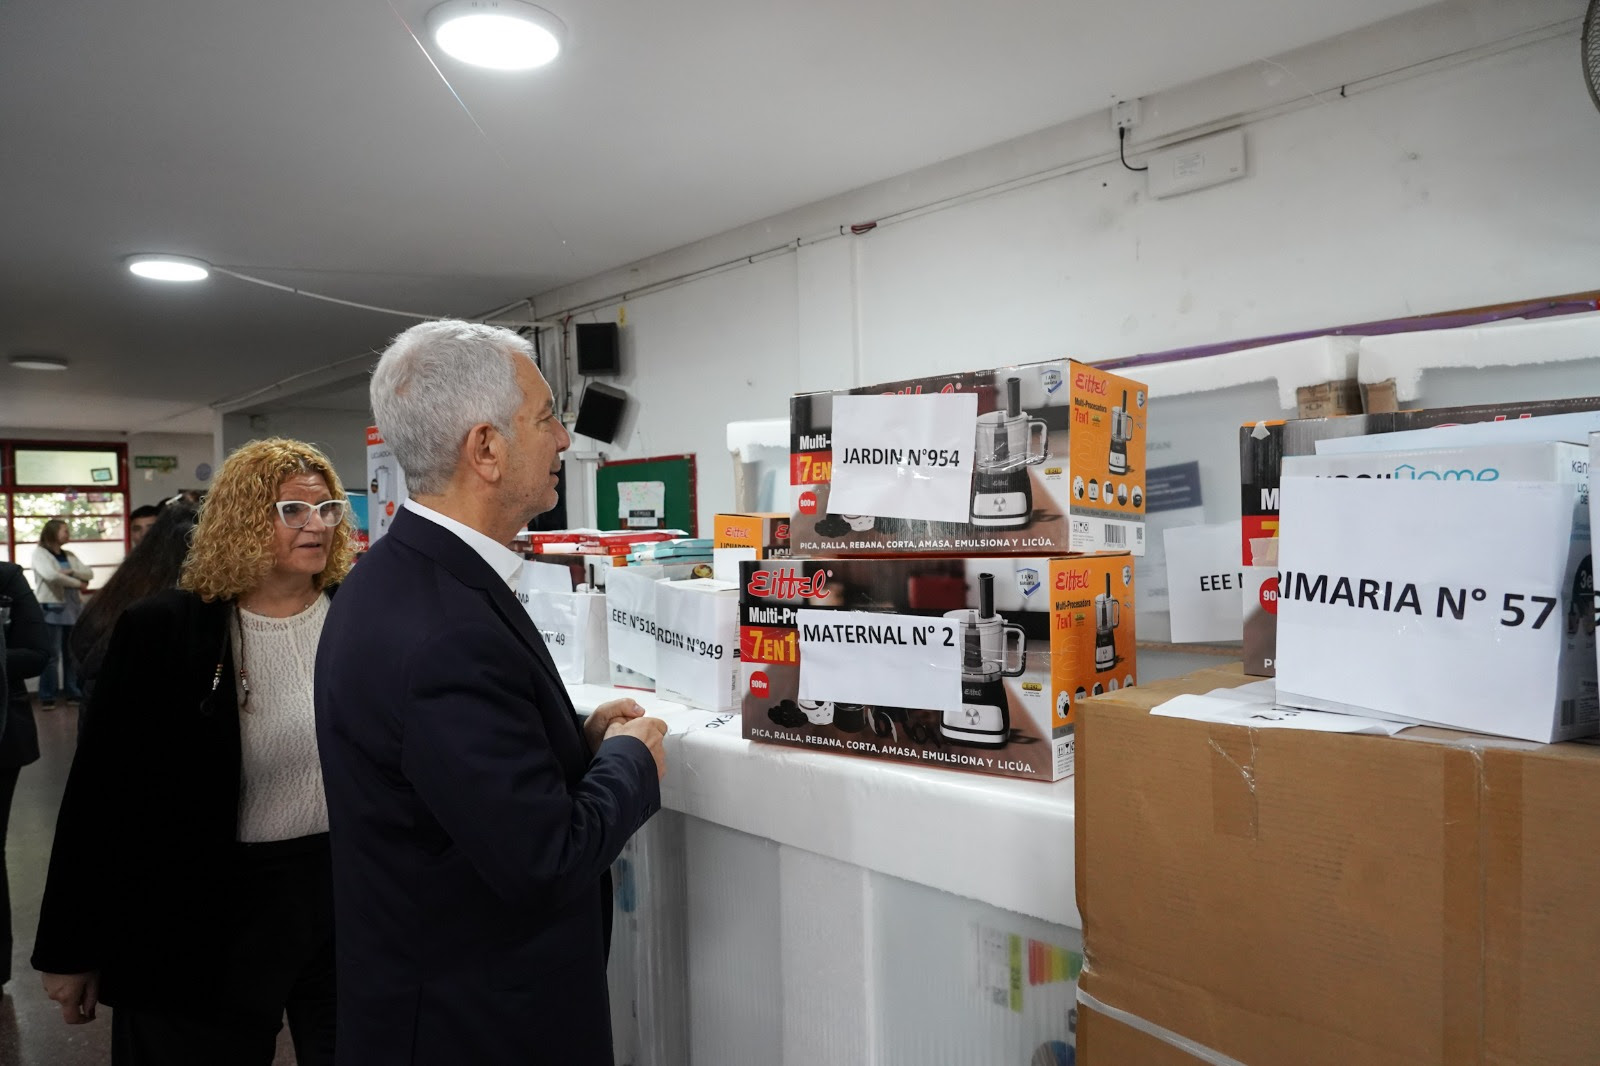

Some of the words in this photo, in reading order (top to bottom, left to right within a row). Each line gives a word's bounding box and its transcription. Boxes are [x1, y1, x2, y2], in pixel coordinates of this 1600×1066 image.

[800, 433, 832, 450] Multi-
[800, 456, 832, 482] 7EN
[843, 448, 902, 465] JARDIN
[908, 449, 960, 467] N°954
[800, 542, 820, 550] PICA,
[821, 541, 848, 550] RALLA,
[850, 541, 885, 549] REBANA,
[887, 540, 917, 549] CORTA,
[919, 540, 953, 549] AMASA,
[955, 539, 1010, 548] EMULSIONA
[1012, 539, 1018, 547] Y
[1200, 574, 1232, 591] EEE
[1437, 586, 1487, 620] N°
[1500, 593, 1557, 630] 57
[612, 609, 627, 625] EEE
[630, 615, 656, 636] N°518
[555, 633, 565, 646] 49
[655, 628, 683, 648] RDIN
[687, 637, 723, 660] N°949
[803, 624, 907, 645] MATERNAL
[913, 625, 935, 646] N°
[943, 627, 954, 647] 2
[751, 728, 773, 739] PICA,
[774, 731, 804, 743] RALLA,
[805, 735, 844, 749] REBANA,
[846, 740, 880, 753] CORTA,
[881, 745, 920, 759] AMASA,
[922, 750, 984, 767] EMULSIONA
[986, 759, 993, 768] Y
[998, 760, 1036, 773] LICÚA.
